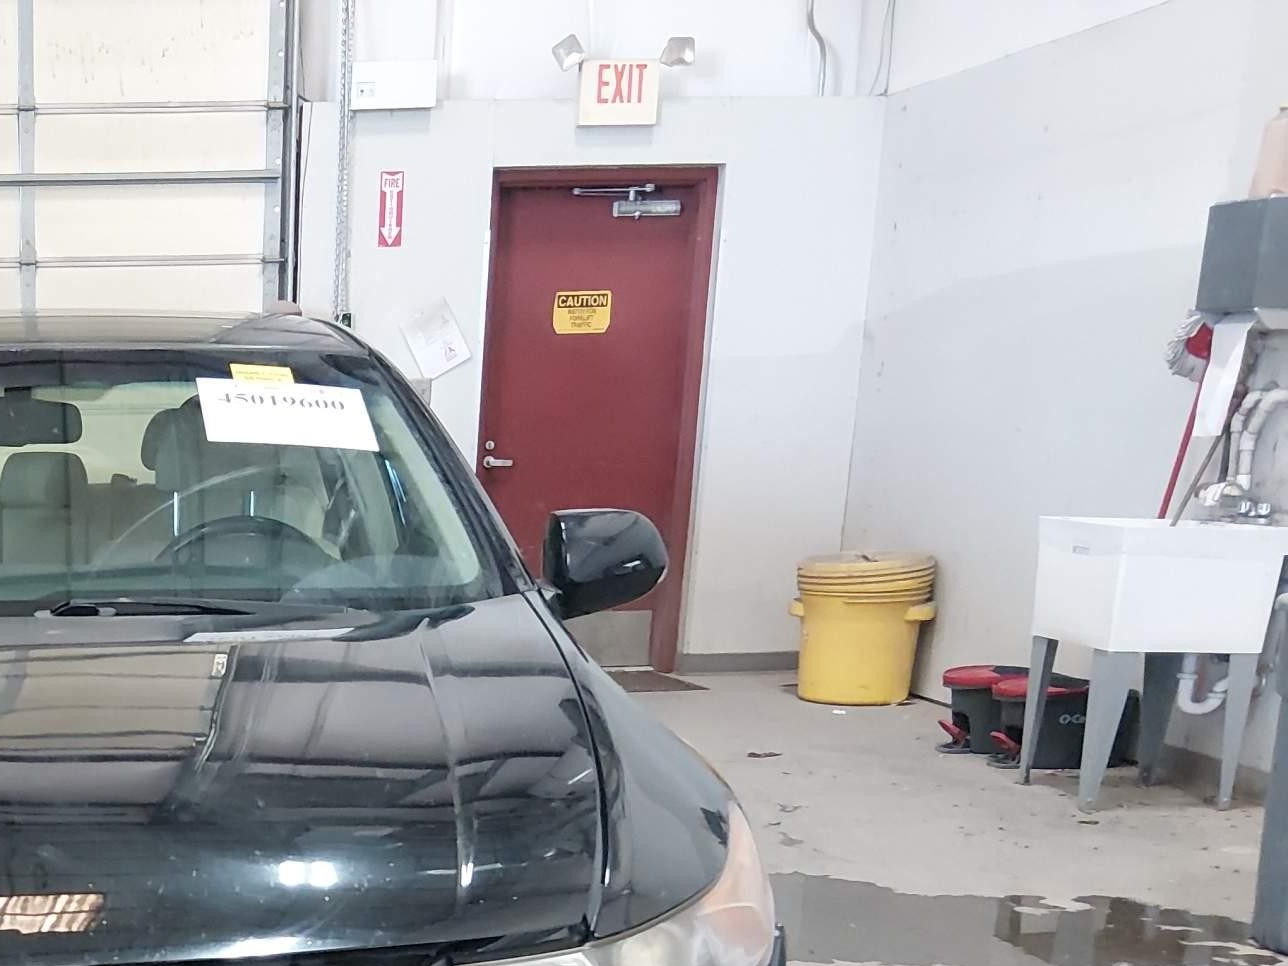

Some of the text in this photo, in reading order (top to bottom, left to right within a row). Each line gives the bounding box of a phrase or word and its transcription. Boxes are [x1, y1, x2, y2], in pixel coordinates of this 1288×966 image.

[597, 64, 648, 103] EXIT
[384, 178, 400, 188] FIRE
[558, 295, 608, 307] CAUTION
[217, 392, 345, 411] 45019600
